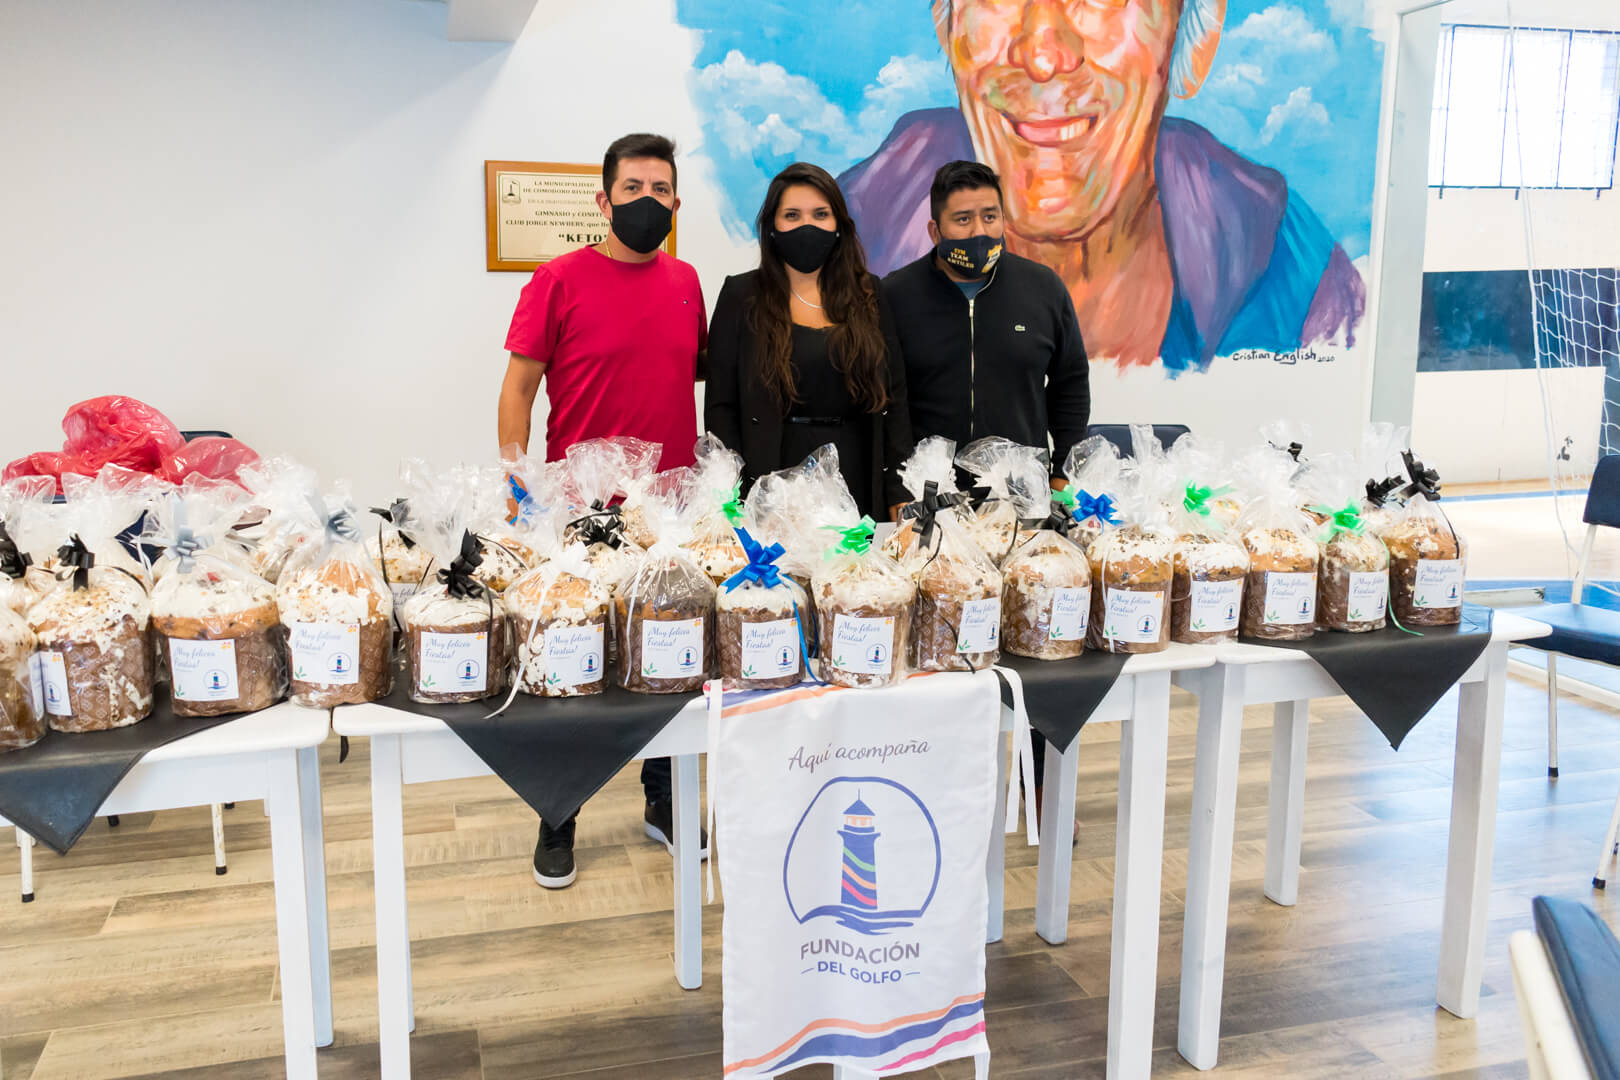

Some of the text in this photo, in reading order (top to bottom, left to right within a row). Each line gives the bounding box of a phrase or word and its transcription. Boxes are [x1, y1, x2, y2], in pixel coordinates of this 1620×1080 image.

[1232, 349, 1270, 361] Cristian
[1273, 346, 1317, 365] English
[788, 739, 931, 774] Aquí acompaña
[800, 938, 920, 965] FUNDACIÓN
[817, 960, 902, 984] DEL GOLFO
